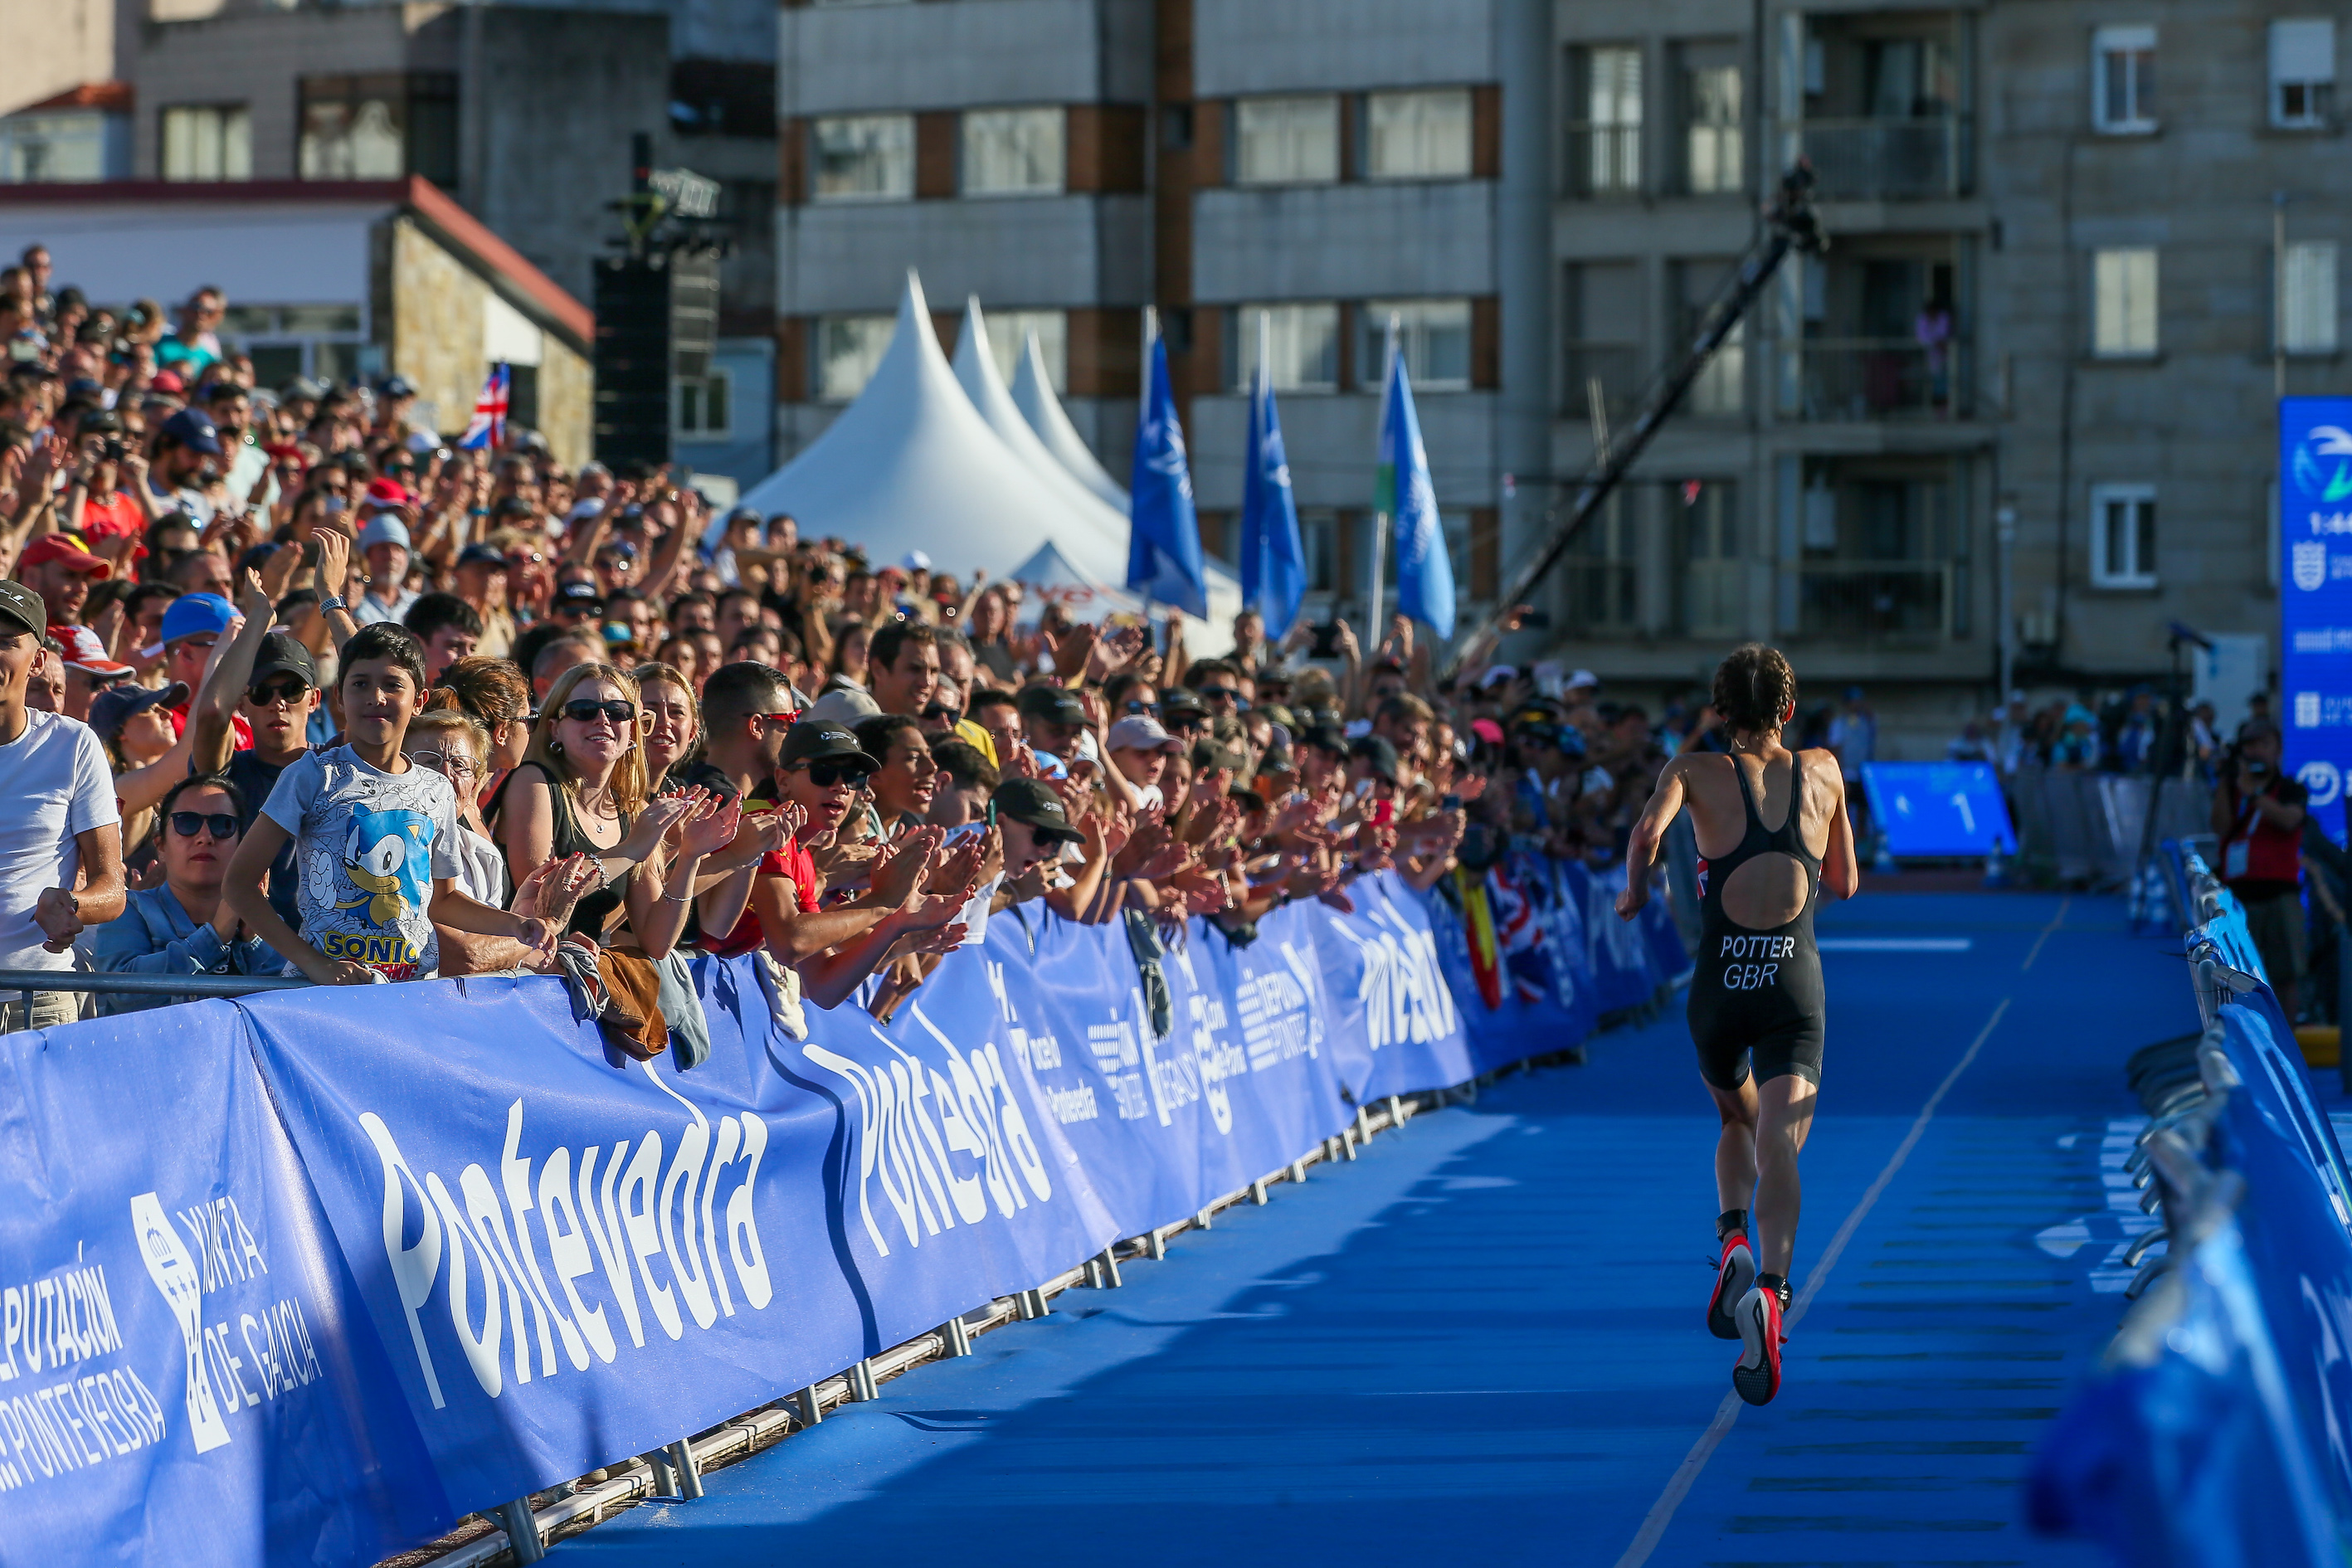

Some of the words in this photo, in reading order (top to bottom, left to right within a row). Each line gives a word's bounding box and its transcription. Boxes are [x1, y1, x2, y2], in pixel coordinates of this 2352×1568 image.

[324, 931, 418, 966] SONIC
[1720, 935, 1795, 959] POTTER
[1724, 962, 1779, 991] GBR
[177, 1195, 269, 1295] XUNTA
[358, 1060, 773, 1410] Pontevedra
[204, 1321, 261, 1415] DE
[240, 1296, 324, 1401] GALICIA
